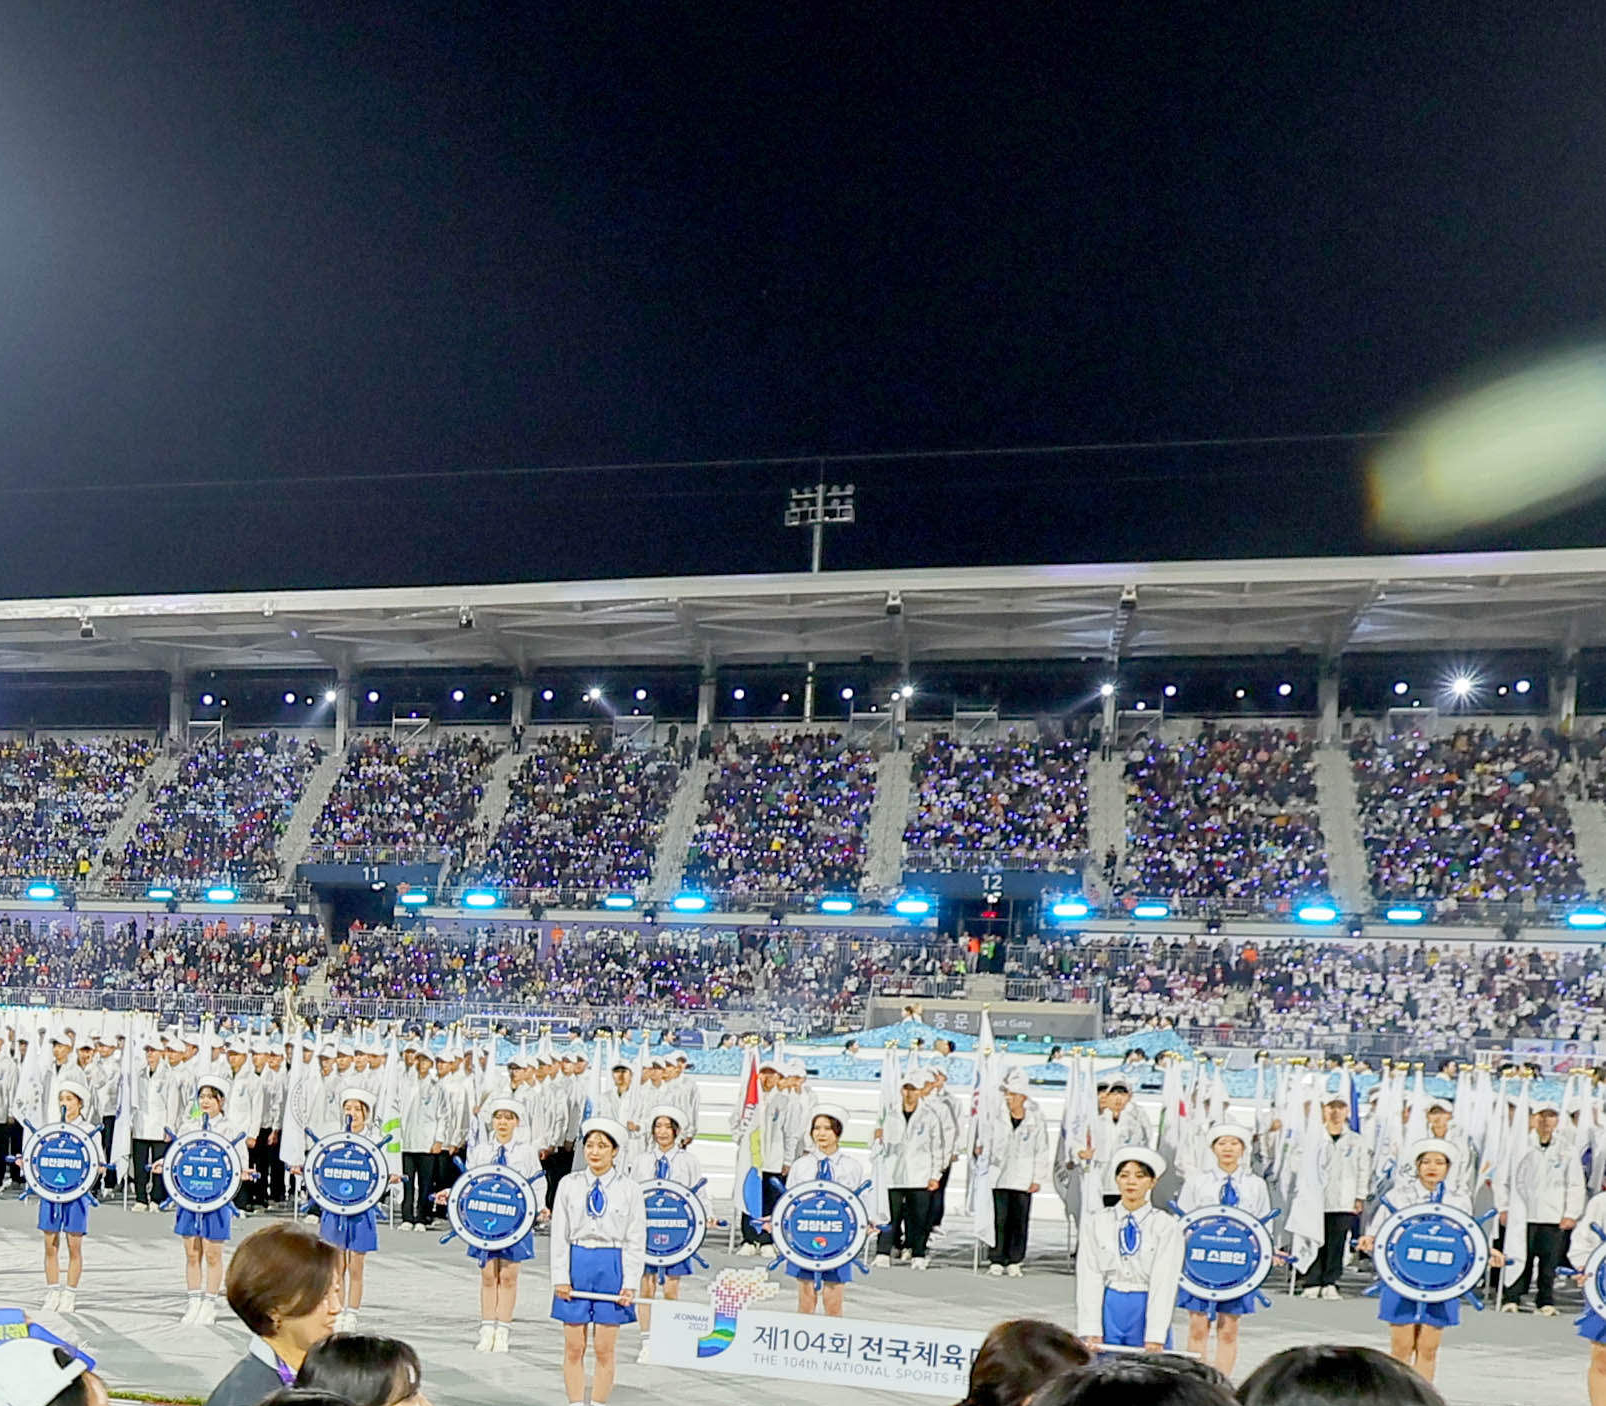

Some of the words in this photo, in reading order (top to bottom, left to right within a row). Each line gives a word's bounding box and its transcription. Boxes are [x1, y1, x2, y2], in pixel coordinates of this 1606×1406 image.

[362, 866, 379, 881] 11
[982, 875, 1003, 890] 12
[672, 1312, 709, 1323] JEONNAM
[752, 1325, 853, 1359] 제104회
[857, 1335, 979, 1371] 전국체육
[752, 1352, 778, 1366] THE
[782, 1355, 818, 1370] 104th
[822, 1360, 890, 1379] NATIONAL
[894, 1367, 949, 1386] SPORTS
